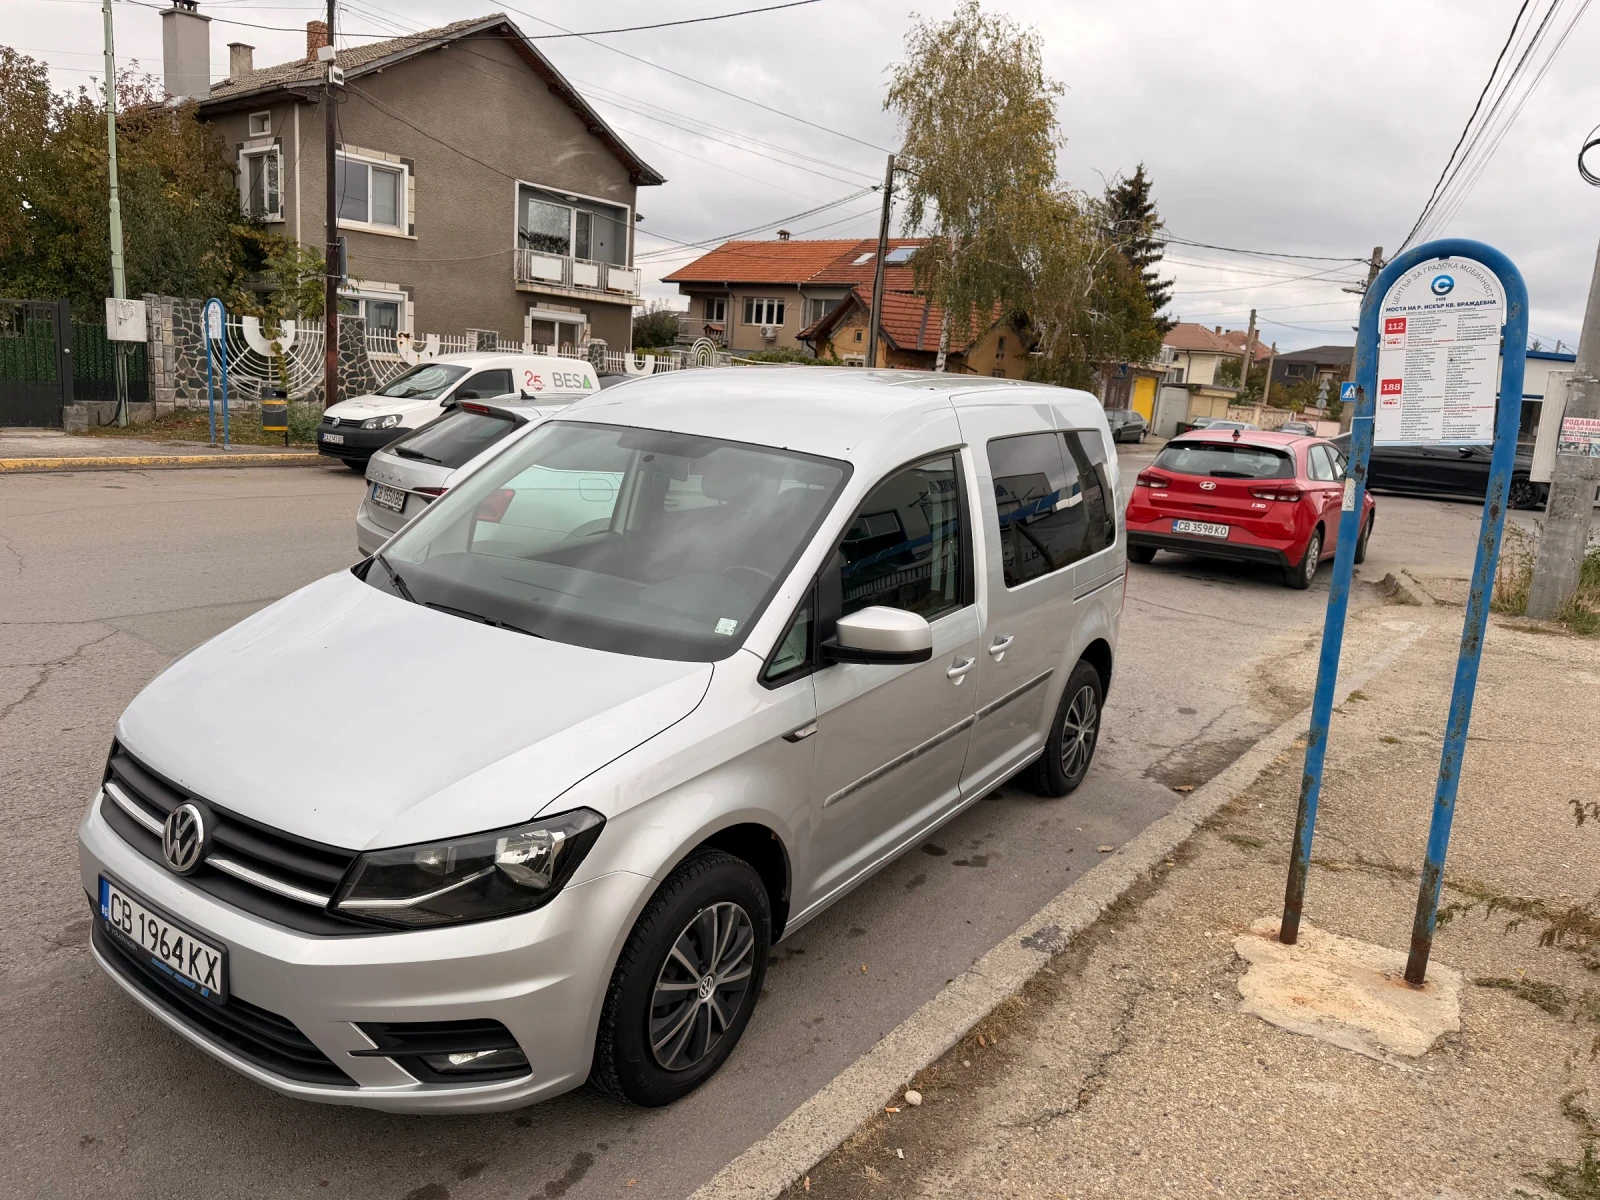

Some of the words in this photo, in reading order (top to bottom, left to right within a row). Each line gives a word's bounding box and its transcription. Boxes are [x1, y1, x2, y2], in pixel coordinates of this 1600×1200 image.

[1392, 278, 1412, 306] ЦЕНТЪР
[1412, 271, 1424, 281] ЗА
[1459, 264, 1494, 298] МОБИЛНОСТ
[1456, 299, 1497, 308] ВРАЖДЕБНА
[1387, 322, 1404, 331] 112
[524, 370, 543, 386] 25
[1382, 383, 1401, 391] 188
[1178, 521, 1190, 531] CB
[1191, 522, 1214, 534] 3598
[139, 912, 184, 970] 1964
